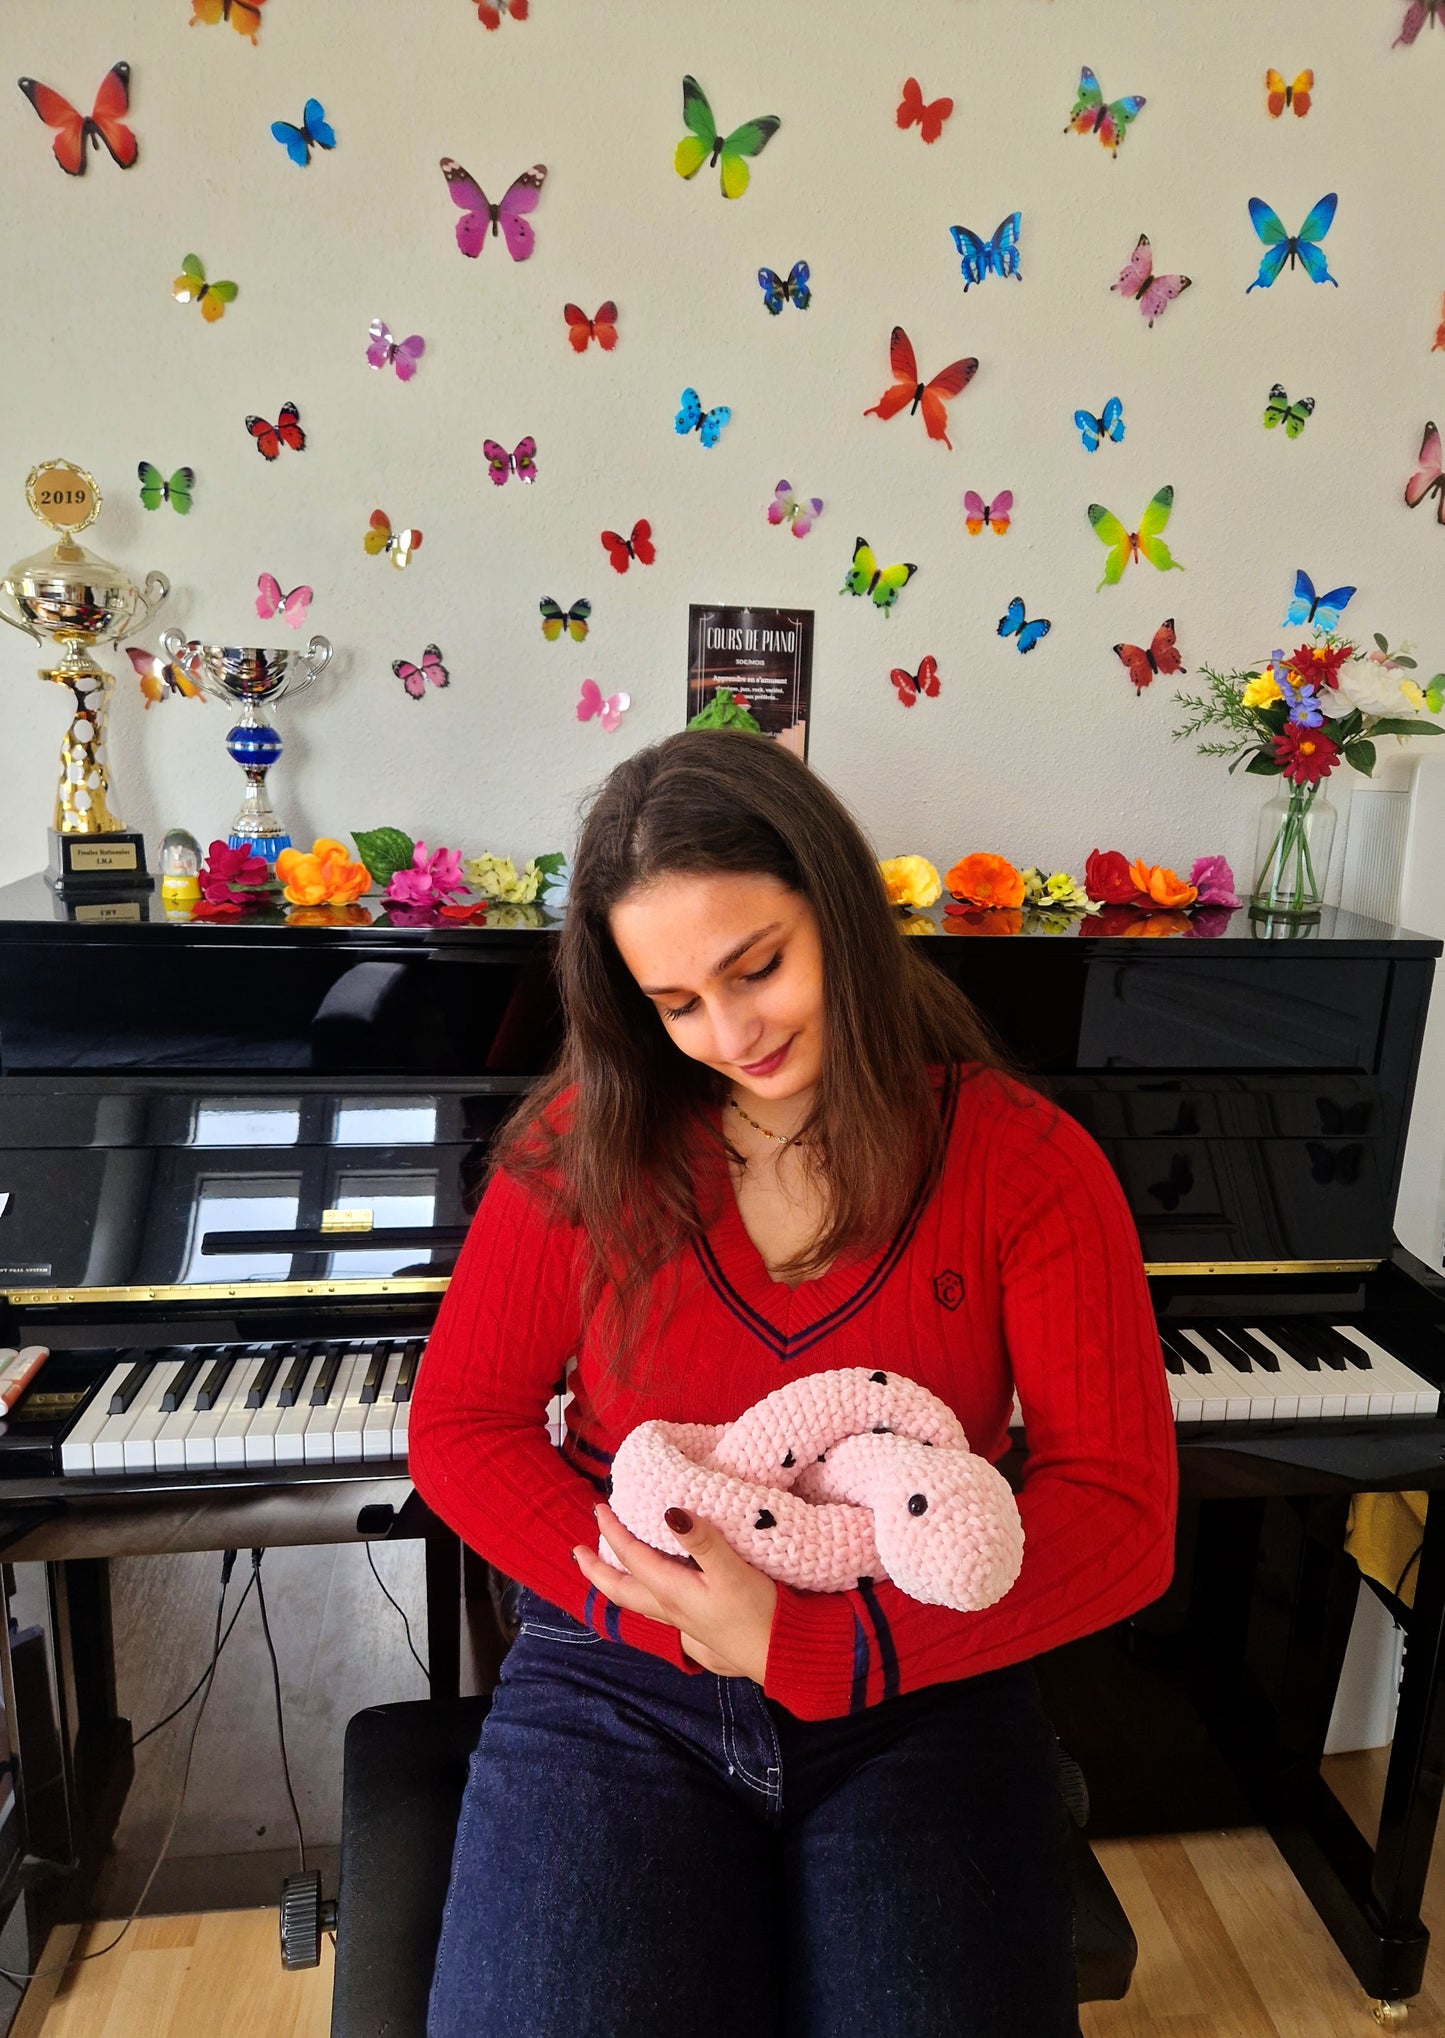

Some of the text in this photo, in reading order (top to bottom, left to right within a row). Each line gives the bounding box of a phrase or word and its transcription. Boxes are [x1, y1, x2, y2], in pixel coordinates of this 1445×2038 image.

[41, 490, 86, 504] 2019
[707, 627, 795, 653] COURS DE PIANO
[713, 675, 746, 683] Apprendre
